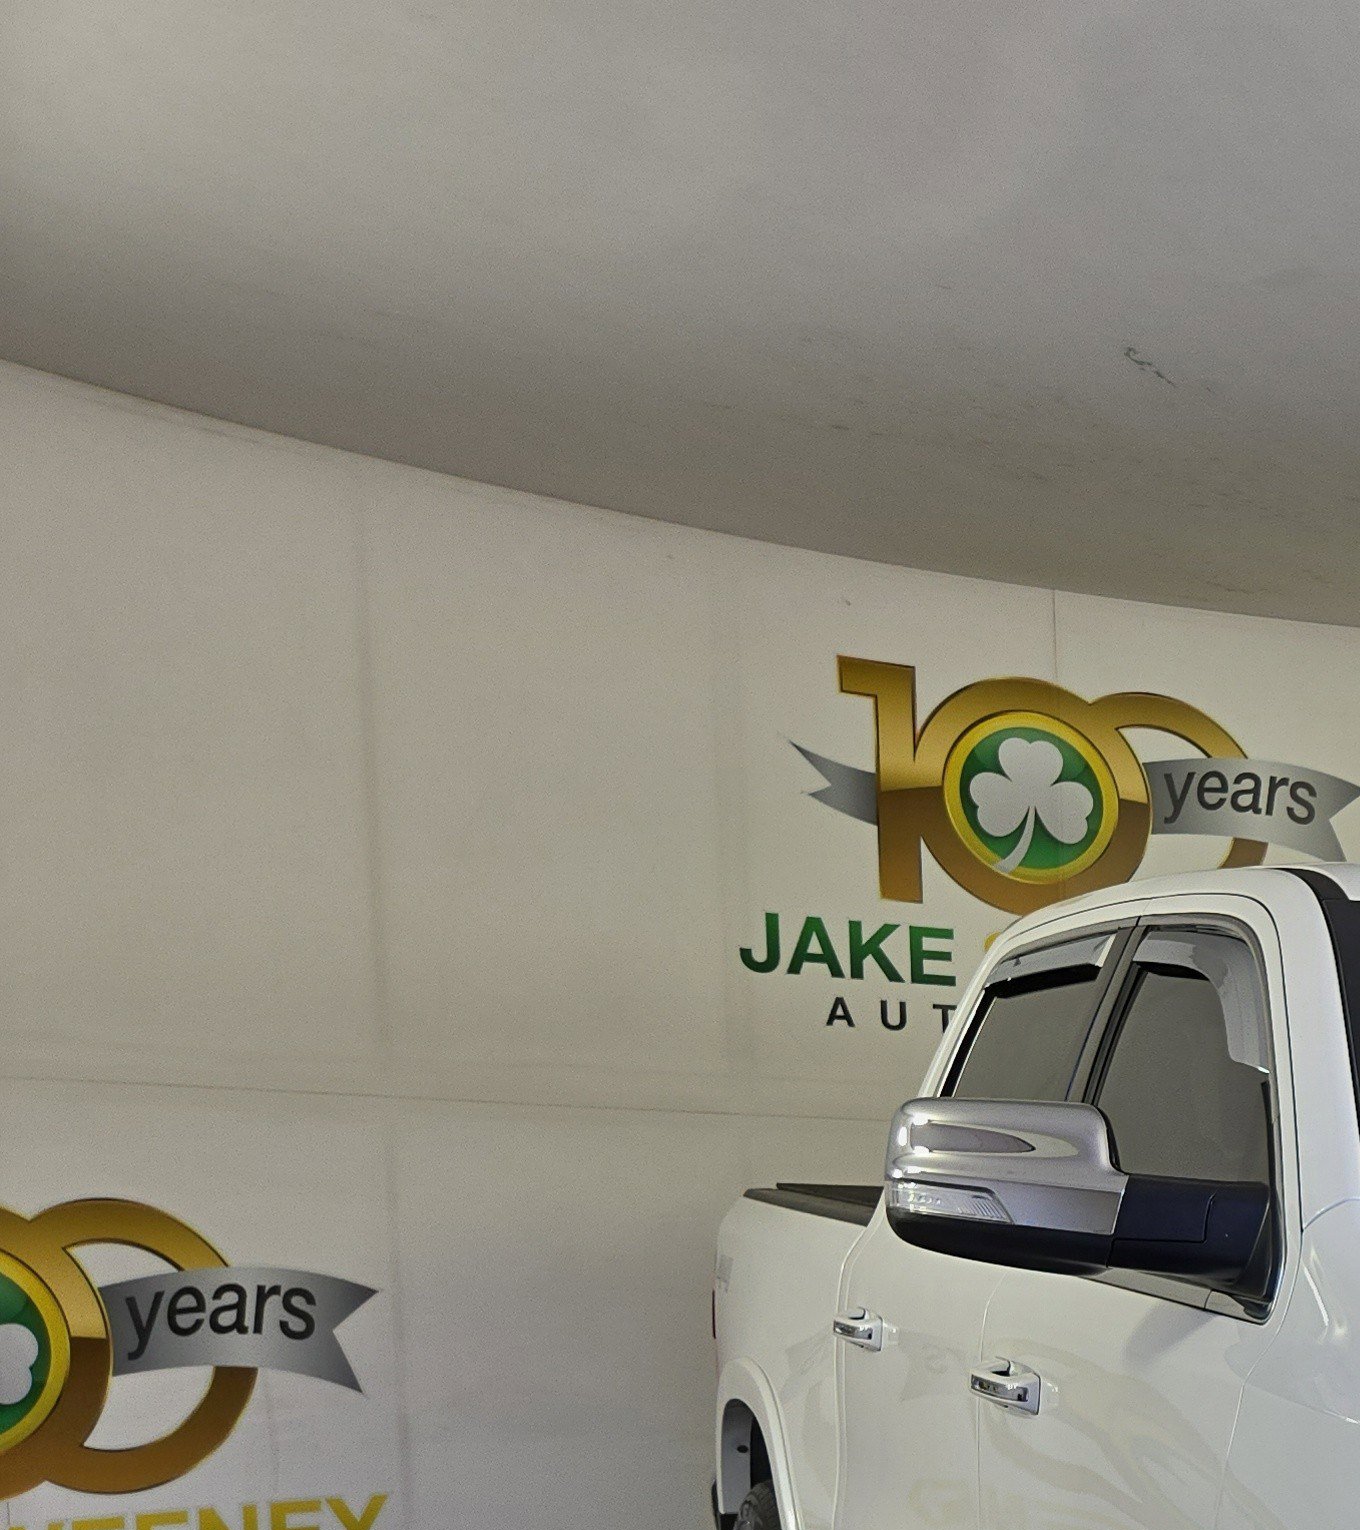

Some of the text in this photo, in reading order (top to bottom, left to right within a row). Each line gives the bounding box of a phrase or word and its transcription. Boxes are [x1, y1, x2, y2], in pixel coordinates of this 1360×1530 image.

[1163, 769, 1318, 825] years
[739, 912, 956, 987] JAKE
[125, 1283, 318, 1361] years
